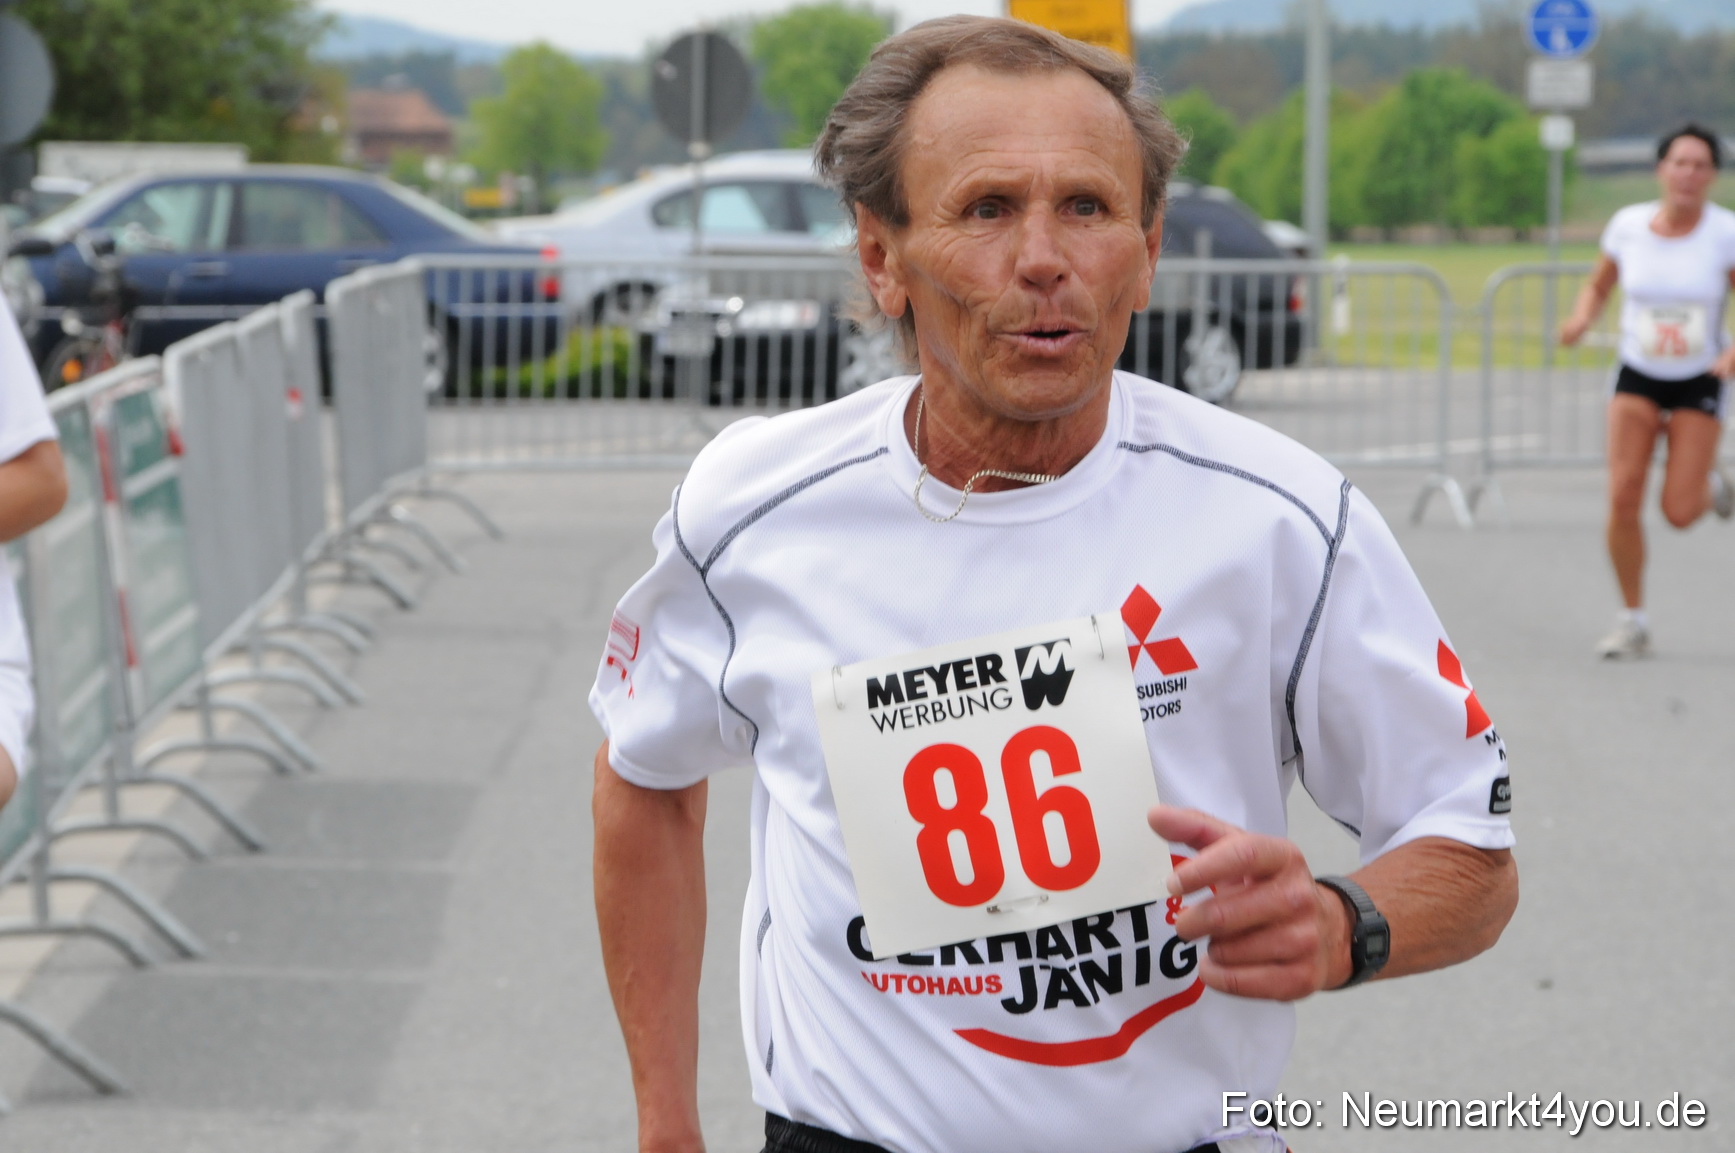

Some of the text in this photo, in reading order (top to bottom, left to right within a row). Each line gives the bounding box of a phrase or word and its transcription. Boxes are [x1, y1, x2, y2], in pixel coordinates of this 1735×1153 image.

[866, 653, 1007, 709] MEYER
[1136, 676, 1188, 700] SUBISHI
[870, 687, 1013, 734] WERBUNG
[1139, 699, 1182, 723] OTORS
[902, 725, 1101, 908] 86
[1000, 936, 1198, 1015] JÄNIG
